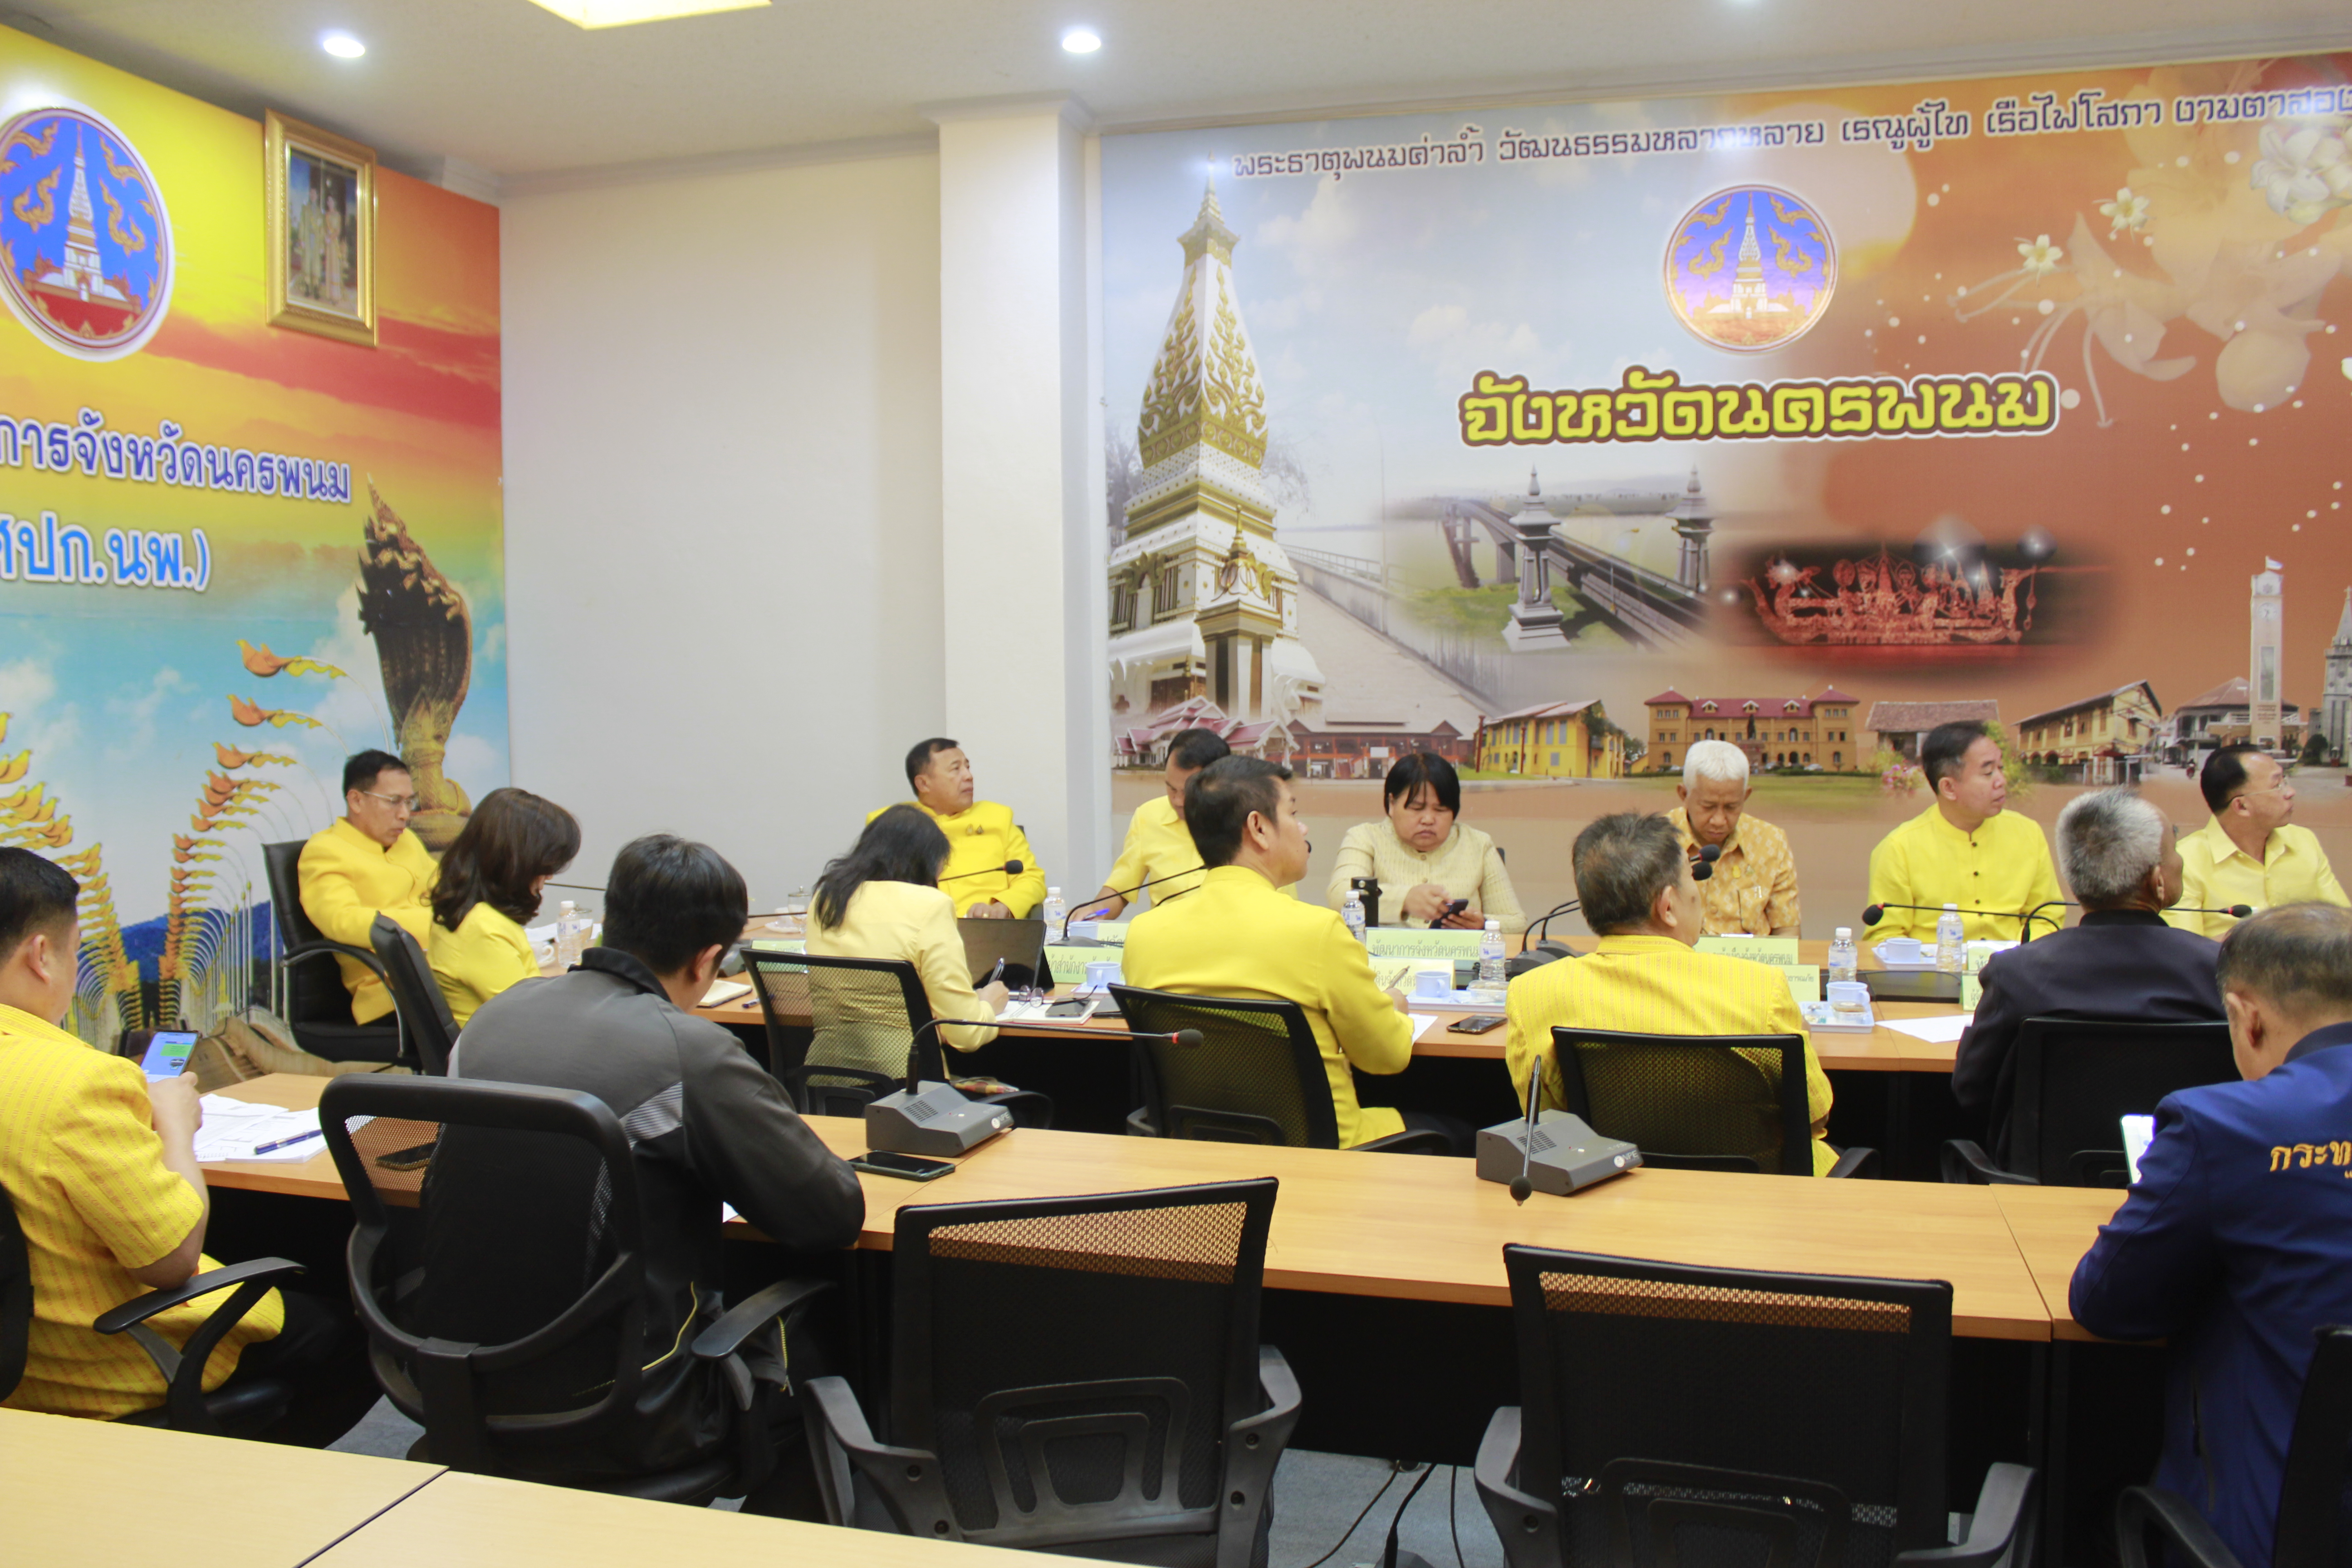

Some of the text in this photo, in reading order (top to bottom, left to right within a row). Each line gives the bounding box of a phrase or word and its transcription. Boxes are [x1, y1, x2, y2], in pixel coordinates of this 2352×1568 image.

[1987, 92, 2161, 135] เรือไฟโสภา
[1463, 373, 2052, 443] จังหวัดนครพนม
